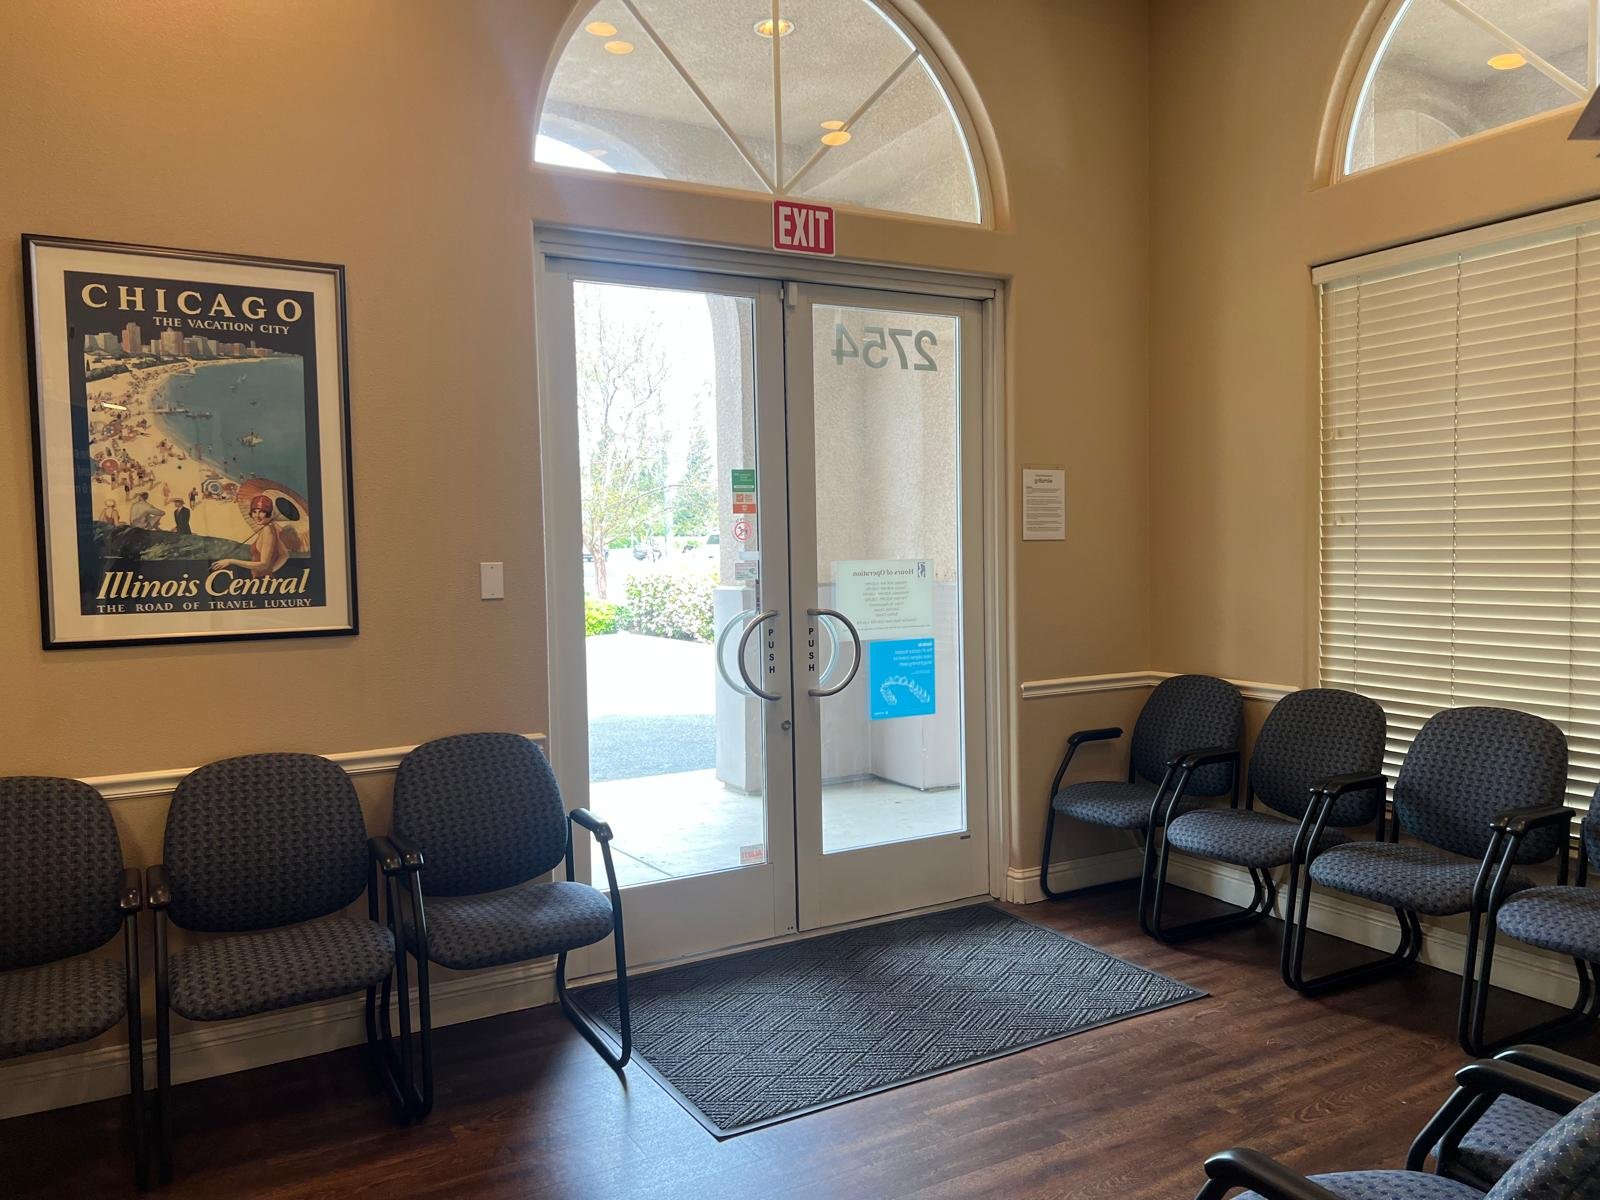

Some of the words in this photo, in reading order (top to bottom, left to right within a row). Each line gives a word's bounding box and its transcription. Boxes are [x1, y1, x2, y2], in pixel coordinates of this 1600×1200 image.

[778, 205, 829, 249] EXIT
[81, 283, 303, 322] CHICAGO
[153, 316, 182, 327] THE
[187, 319, 254, 332] VACATION
[260, 324, 290, 335] CITY
[96, 571, 200, 600] Illinois
[205, 568, 310, 597] Central
[96, 604, 126, 614] THE
[136, 602, 174, 612] ROAD
[183, 601, 200, 611] OF
[208, 600, 256, 610] TRAVEL
[264, 598, 312, 608] LUXURY
[768, 628, 776, 674] PUSH
